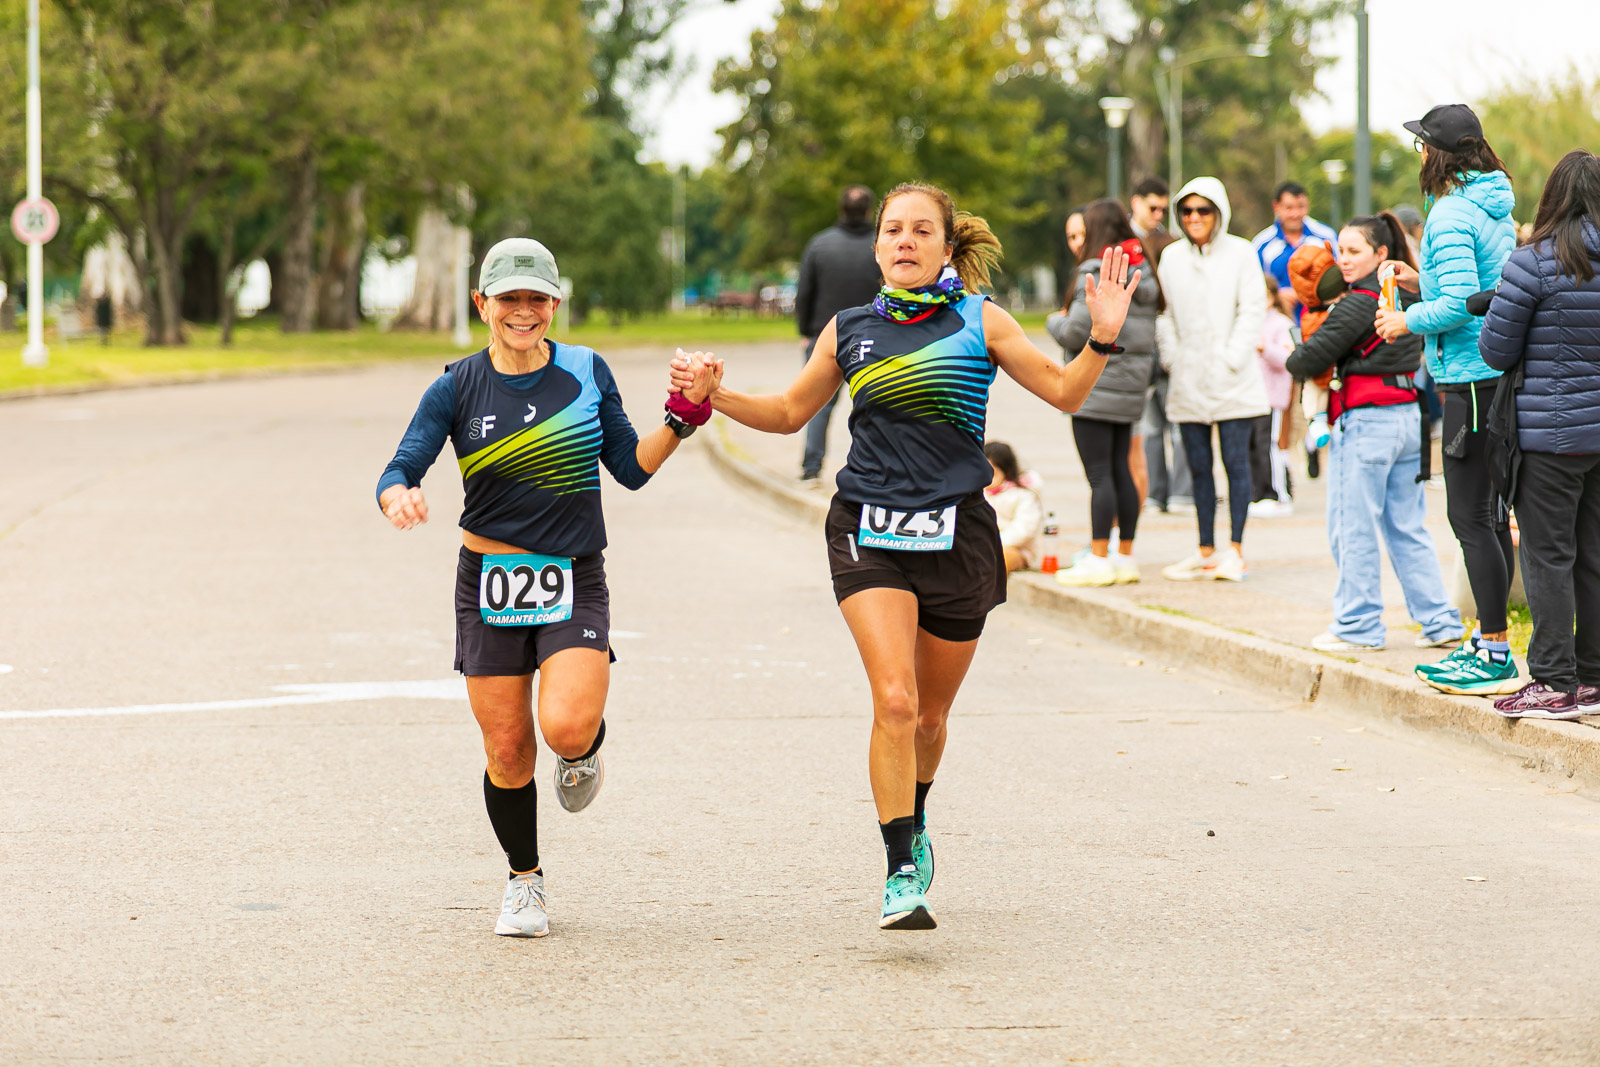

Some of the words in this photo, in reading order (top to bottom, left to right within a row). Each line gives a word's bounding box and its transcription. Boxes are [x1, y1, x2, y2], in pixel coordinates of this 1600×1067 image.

[850, 340, 874, 363] SF
[468, 415, 497, 440] SF
[863, 536, 914, 549] DIAMANTE
[914, 541, 948, 550] CORRE
[486, 564, 564, 612] 029
[486, 613, 535, 624] DIAMANTE
[535, 611, 568, 623] CORRE
